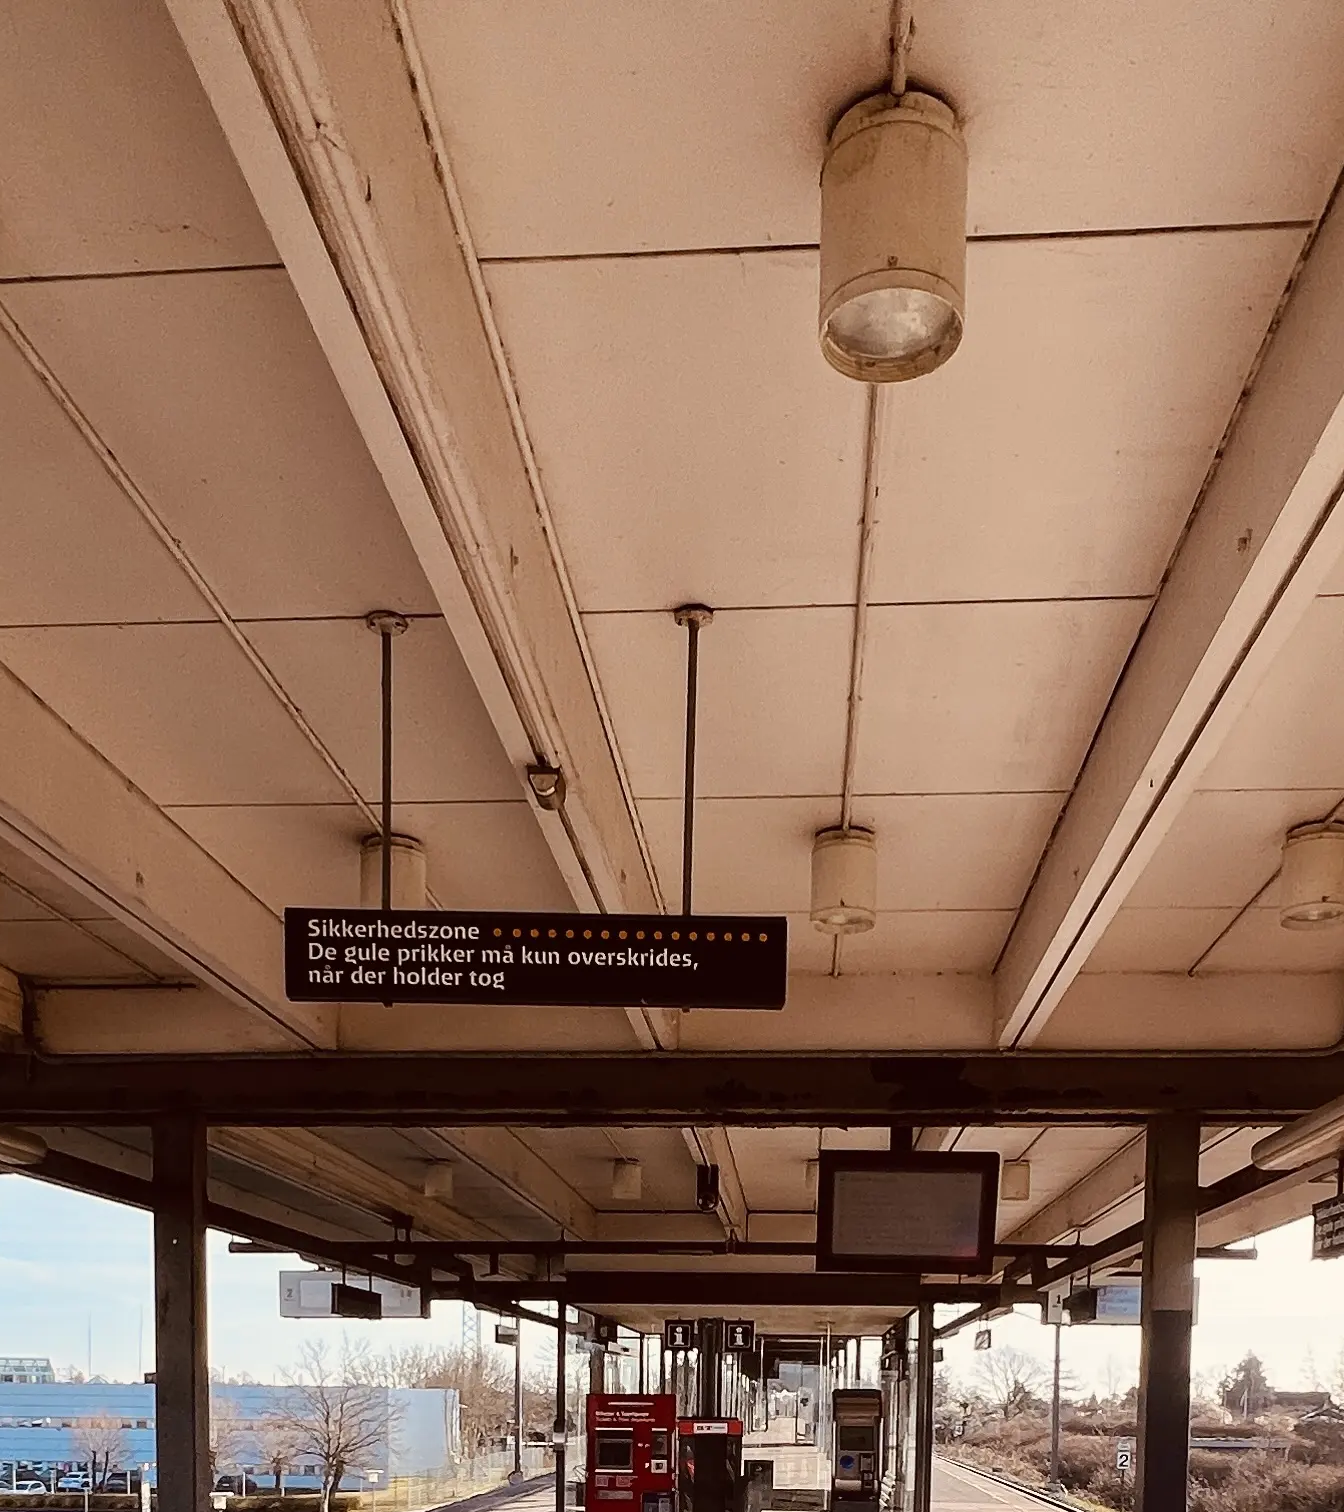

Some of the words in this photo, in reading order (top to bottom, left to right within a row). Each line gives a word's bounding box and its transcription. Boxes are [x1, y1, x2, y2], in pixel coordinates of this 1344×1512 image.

[308, 919, 480, 941] Sikkerhedszone
[308, 944, 337, 962] De
[344, 944, 390, 966] gule
[397, 944, 475, 966] prikker
[481, 945, 514, 964] må
[522, 946, 560, 965] kun
[567, 948, 699, 970] overskrides,
[308, 964, 344, 984] når
[350, 967, 387, 985] der
[394, 967, 462, 987] holder
[469, 971, 505, 989] tog
[1119, 1454, 1128, 1467] 2
